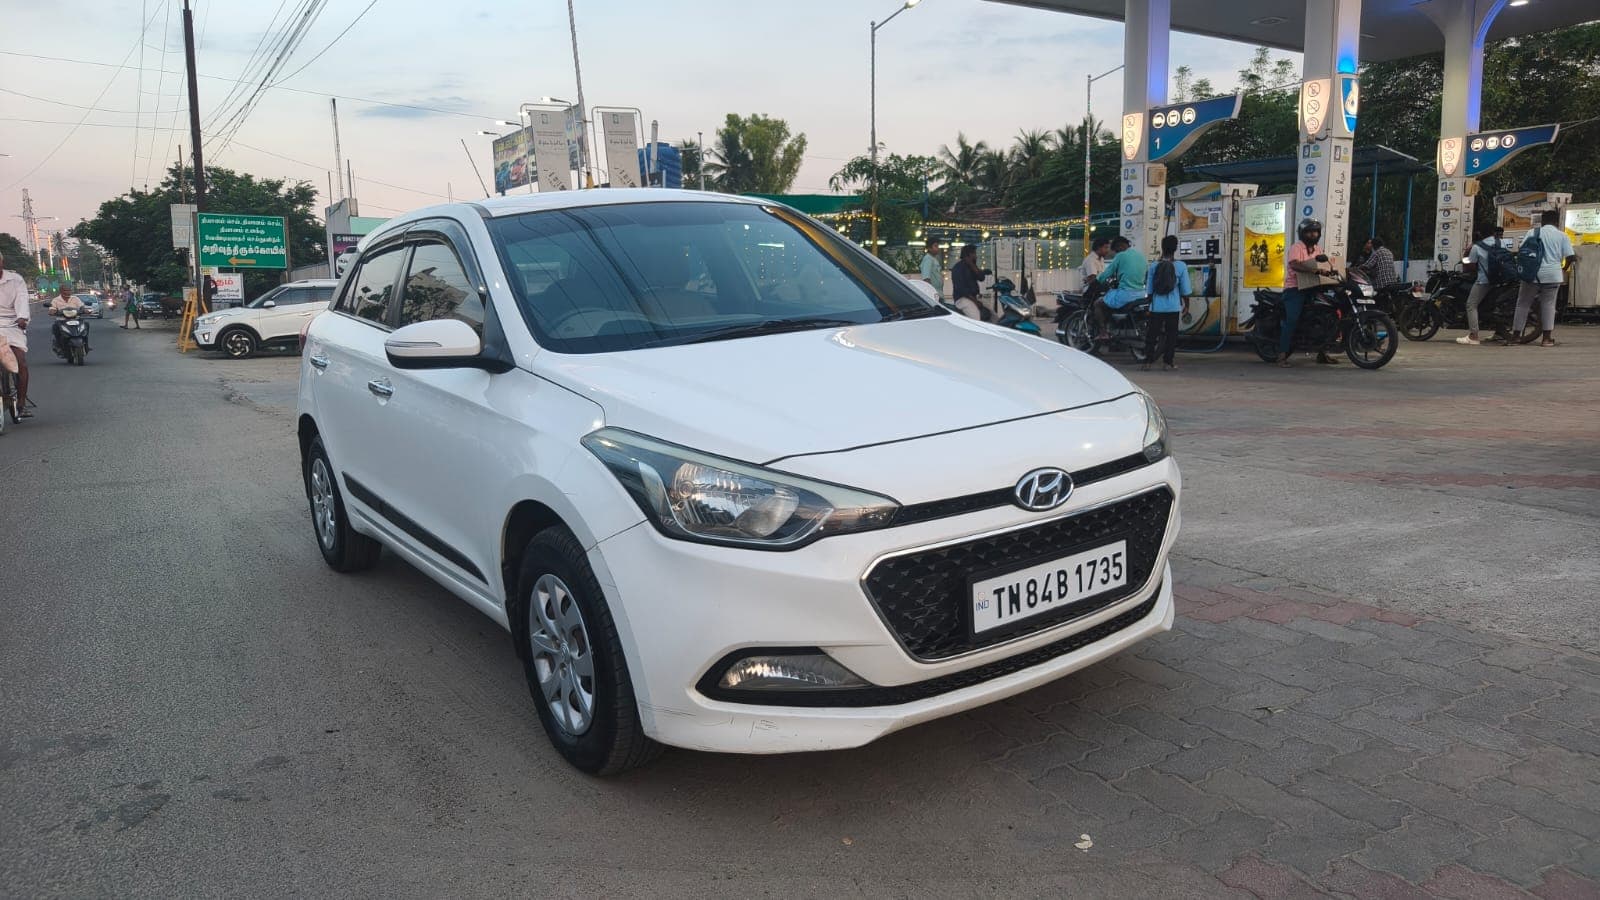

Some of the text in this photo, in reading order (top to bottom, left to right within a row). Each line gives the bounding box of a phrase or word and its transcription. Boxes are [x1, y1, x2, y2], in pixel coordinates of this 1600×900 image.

[1154, 137, 1160, 150] 1
[1472, 159, 1480, 168] 3
[202, 244, 286, 256] அறிவுத்திருக்கோயில்
